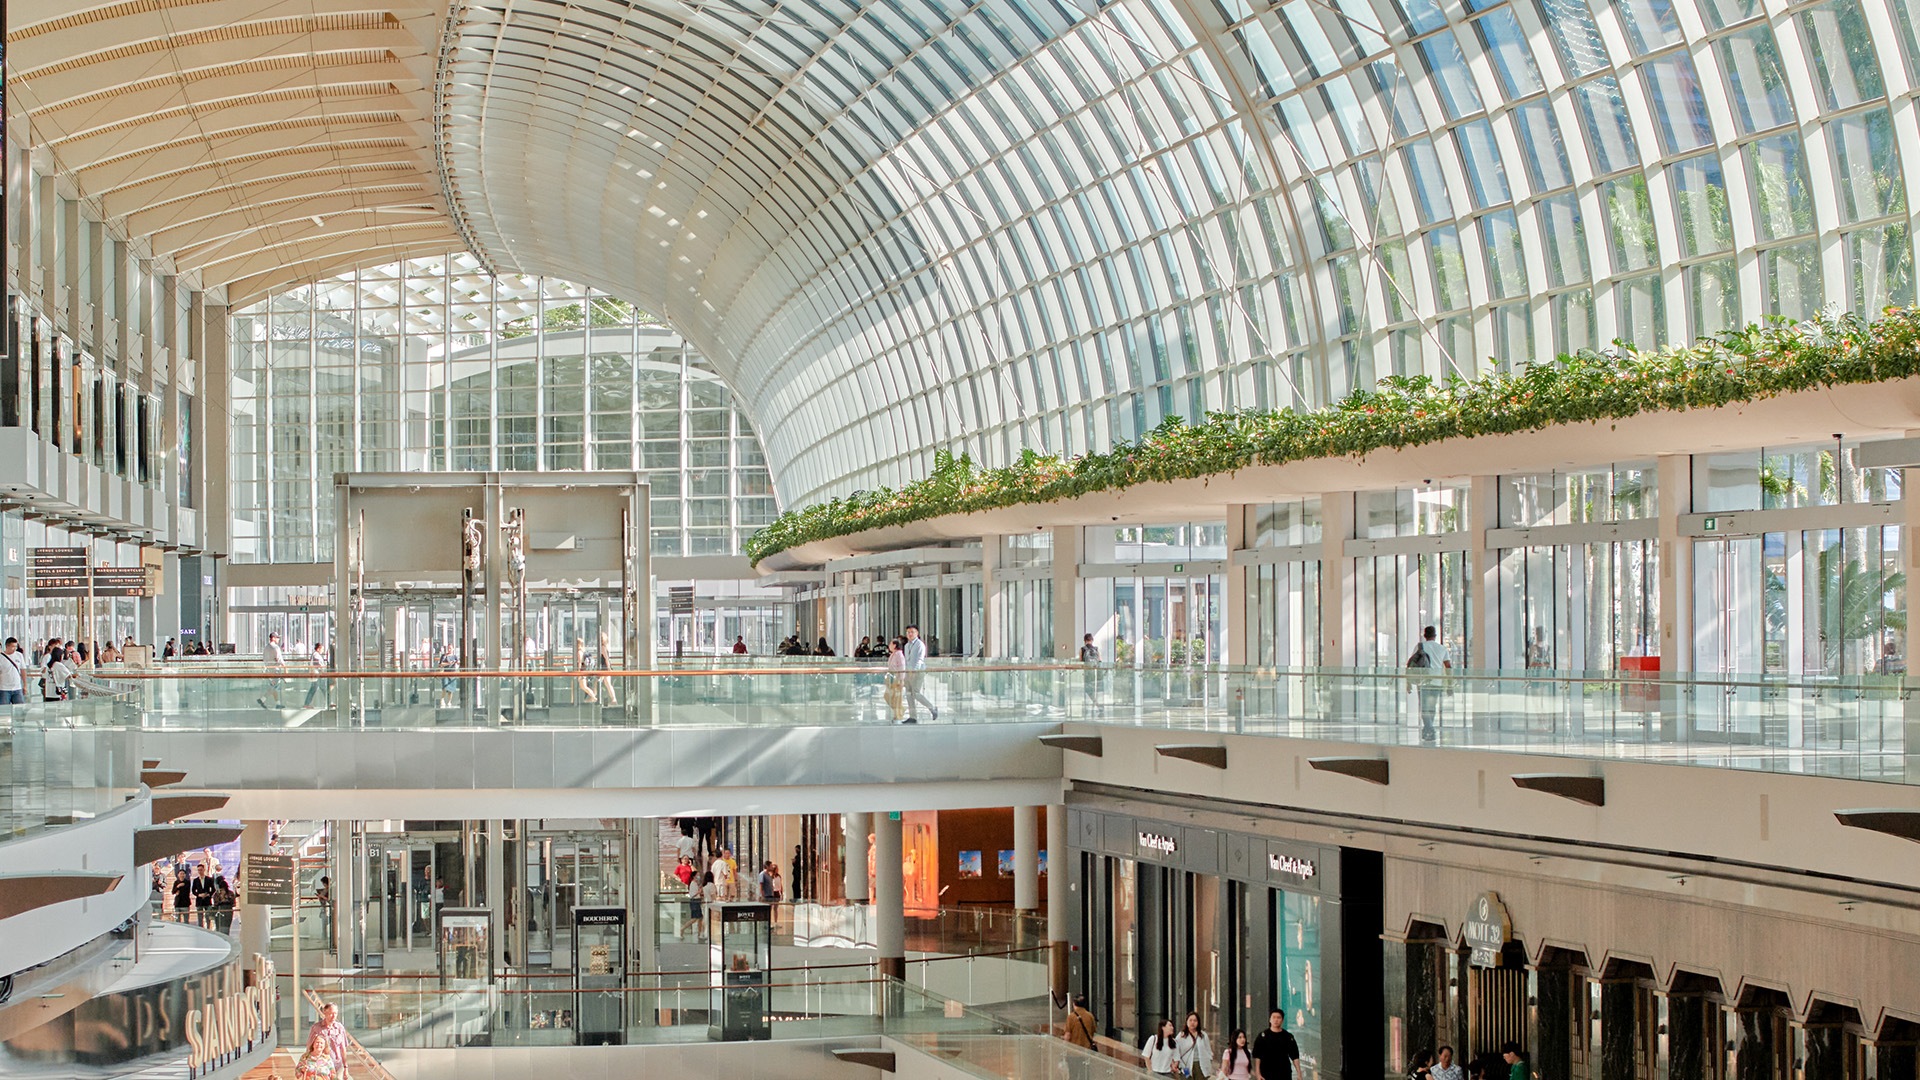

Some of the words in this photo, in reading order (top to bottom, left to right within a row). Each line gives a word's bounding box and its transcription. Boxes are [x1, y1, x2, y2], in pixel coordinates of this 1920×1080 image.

[1139, 832, 1147, 847] Van
[1147, 833, 1158, 848] Cleef
[370, 849, 379, 857] B1
[1270, 854, 1279, 870] Van
[1280, 855, 1293, 872] Cleef
[1298, 859, 1313, 880] Arpels
[1467, 921, 1489, 942] MOTT
[1490, 924, 1500, 944] 32
[185, 986, 258, 1069] SANDS
